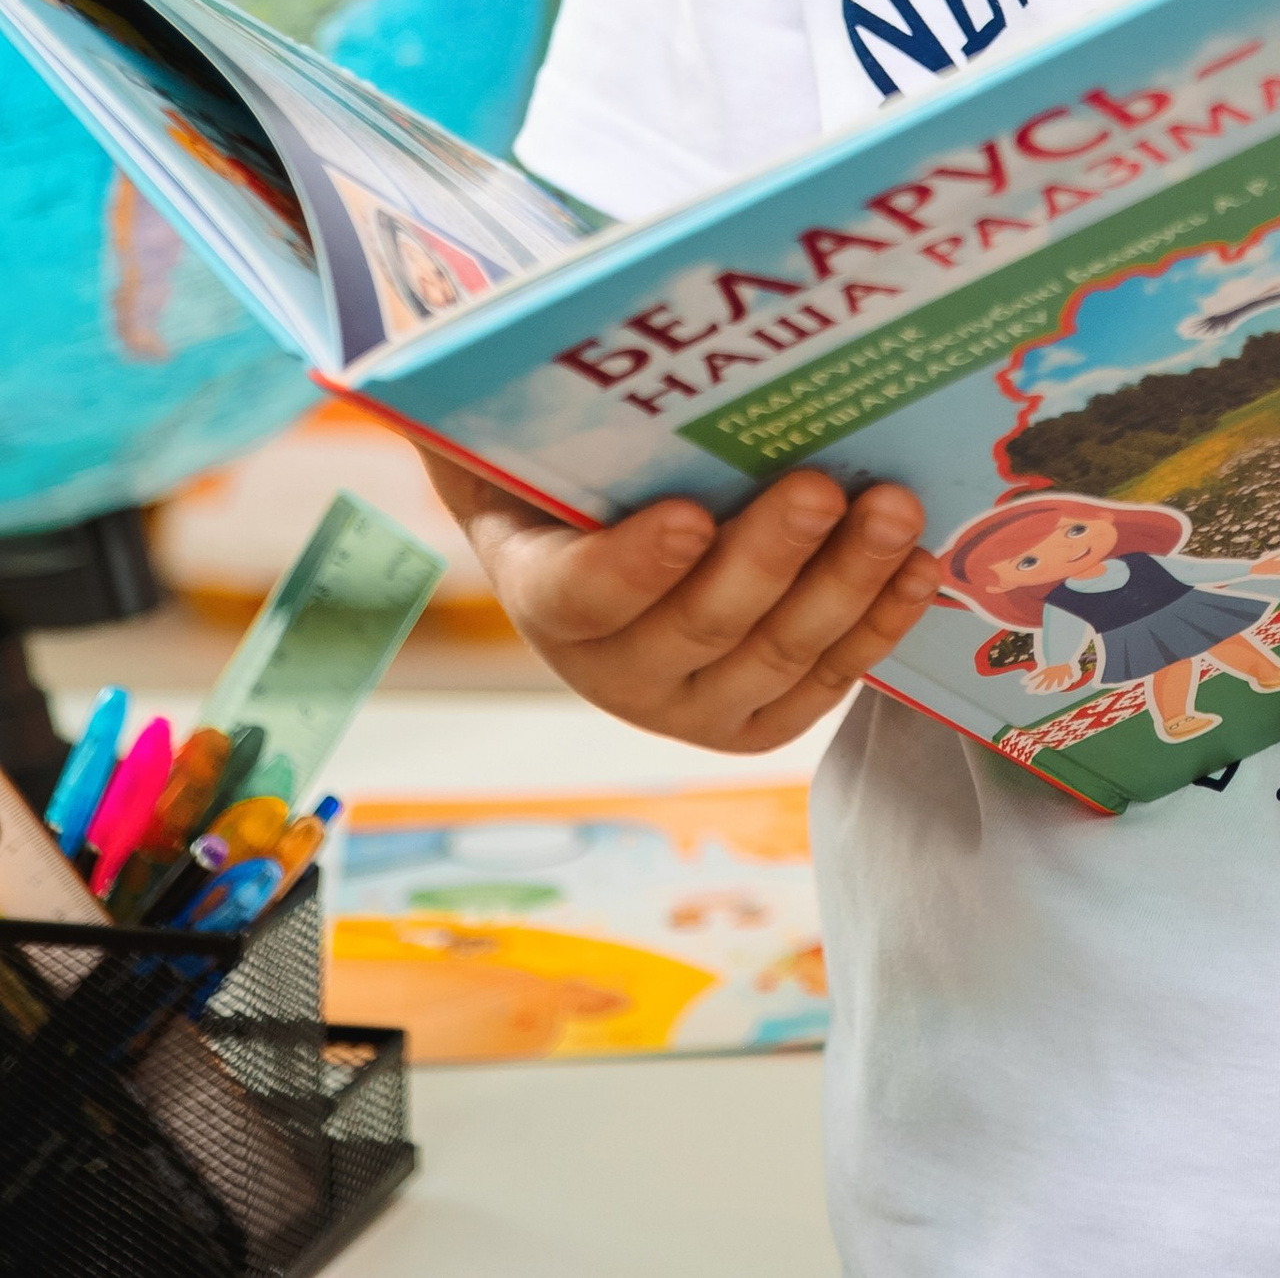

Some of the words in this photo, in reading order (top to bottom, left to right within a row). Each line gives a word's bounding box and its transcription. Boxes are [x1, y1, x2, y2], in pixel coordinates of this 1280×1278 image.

[553, 84, 1175, 391] БЕЛАРУСЬ
[622, 282, 904, 418] НАША
[715, 326, 924, 434] ПАДАРУНАК
[760, 308, 1049, 459] ПЕРШАКЛАСНІКУ
